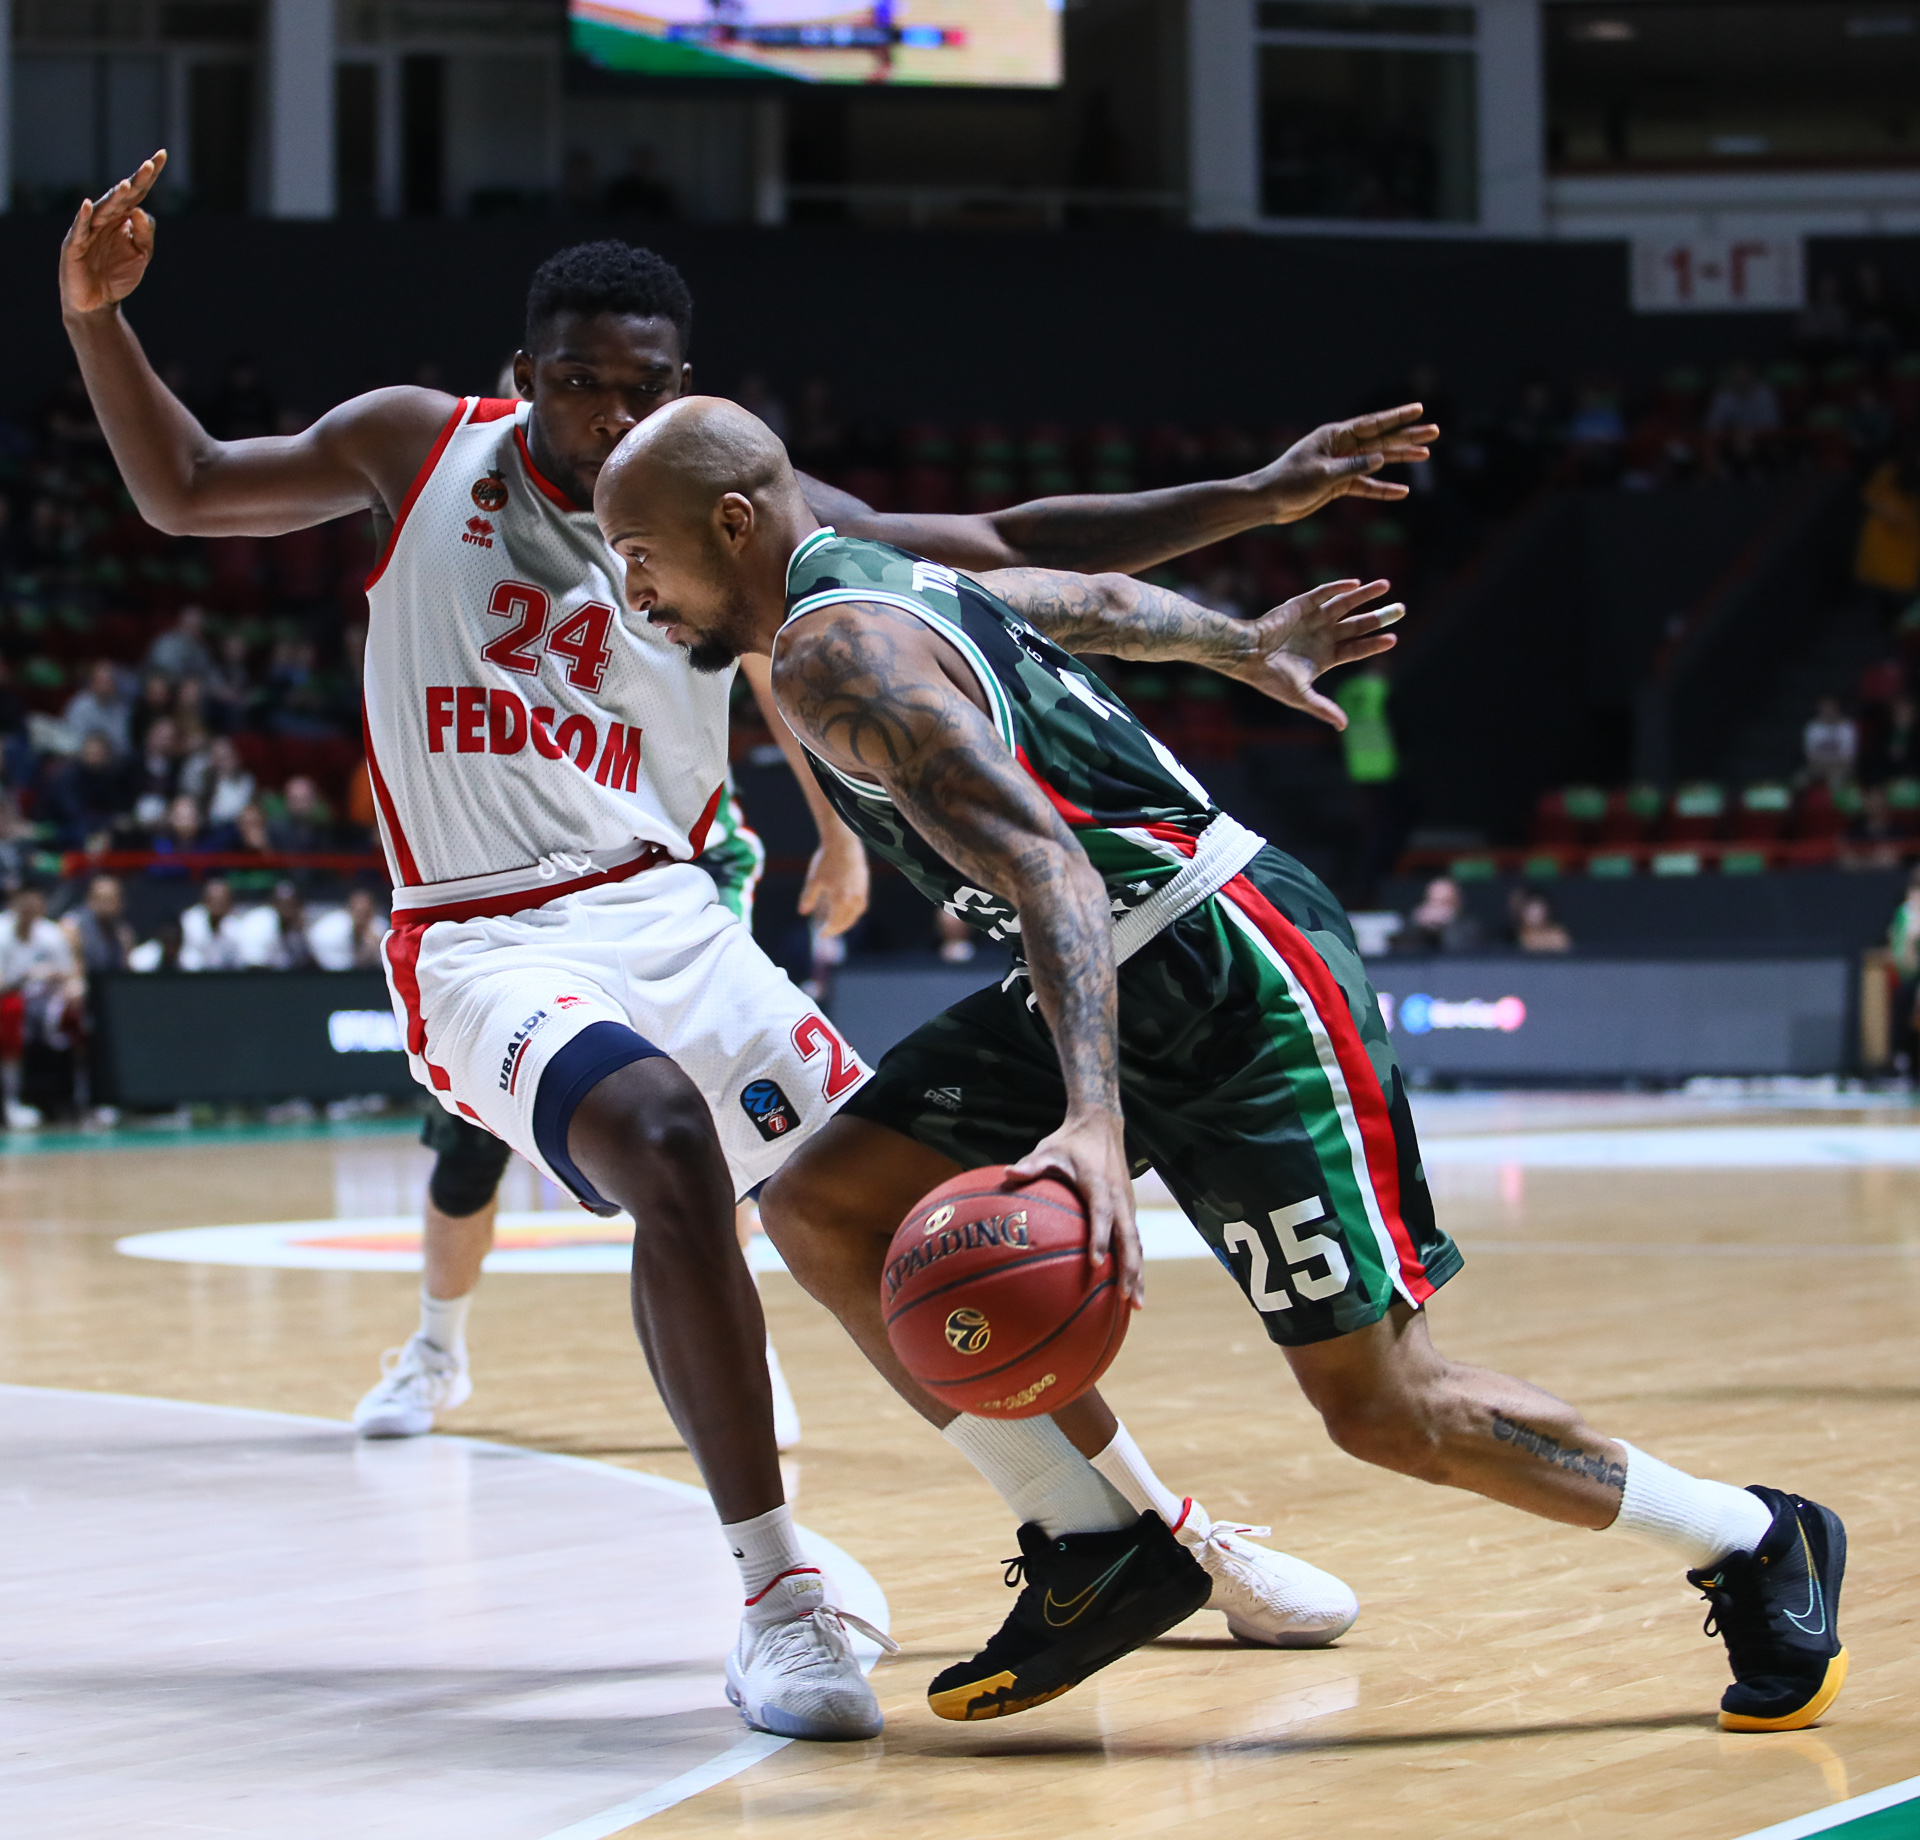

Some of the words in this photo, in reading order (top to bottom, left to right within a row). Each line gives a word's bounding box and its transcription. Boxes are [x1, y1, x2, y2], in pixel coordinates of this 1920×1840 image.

[481, 579, 615, 694] 24
[425, 686, 643, 793] FEDCOM
[499, 1009, 547, 1091] UBALDI
[790, 1011, 865, 1104] 2
[886, 1209, 1030, 1305] SPALDING
[1223, 1196, 1351, 1312] 25
